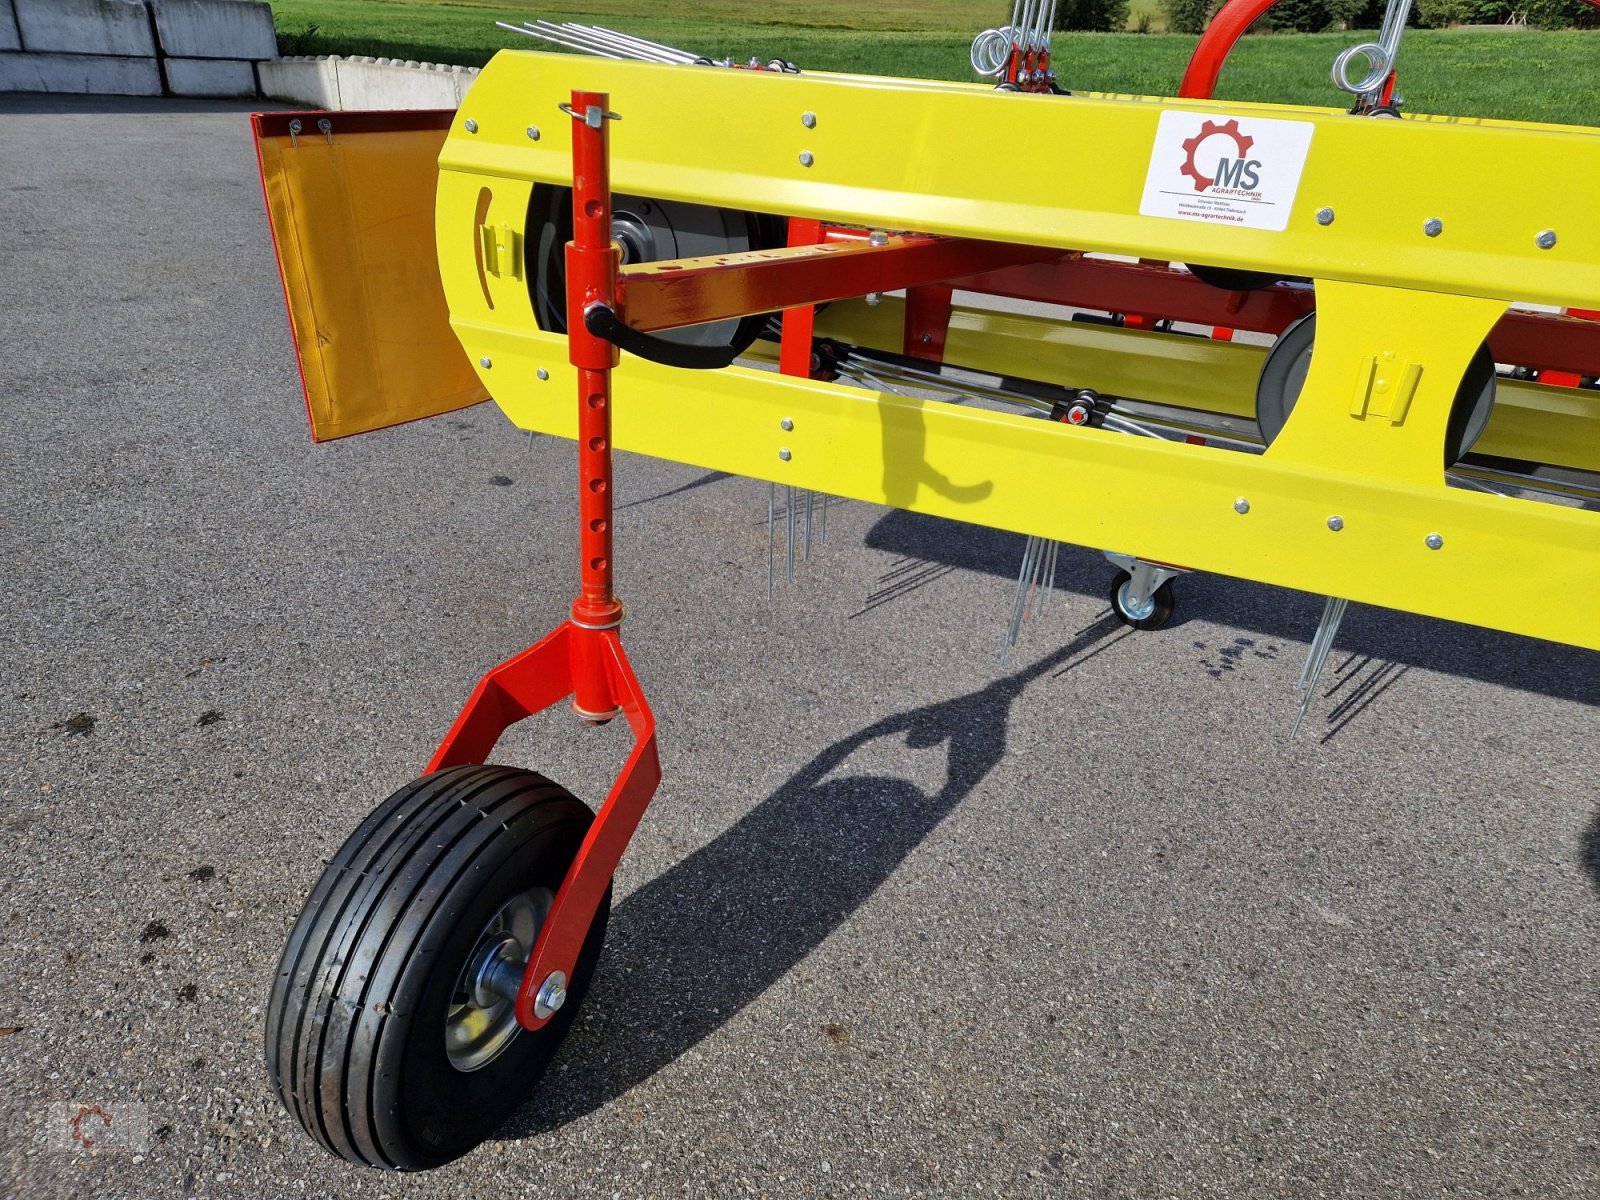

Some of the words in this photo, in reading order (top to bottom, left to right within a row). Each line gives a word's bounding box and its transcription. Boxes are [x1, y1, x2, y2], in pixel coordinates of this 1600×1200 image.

[1214, 157, 1261, 190] MS
[1212, 187, 1262, 197] AGRARTECHNIK
[1177, 209, 1244, 222] www.ms-agrartechnik.de
